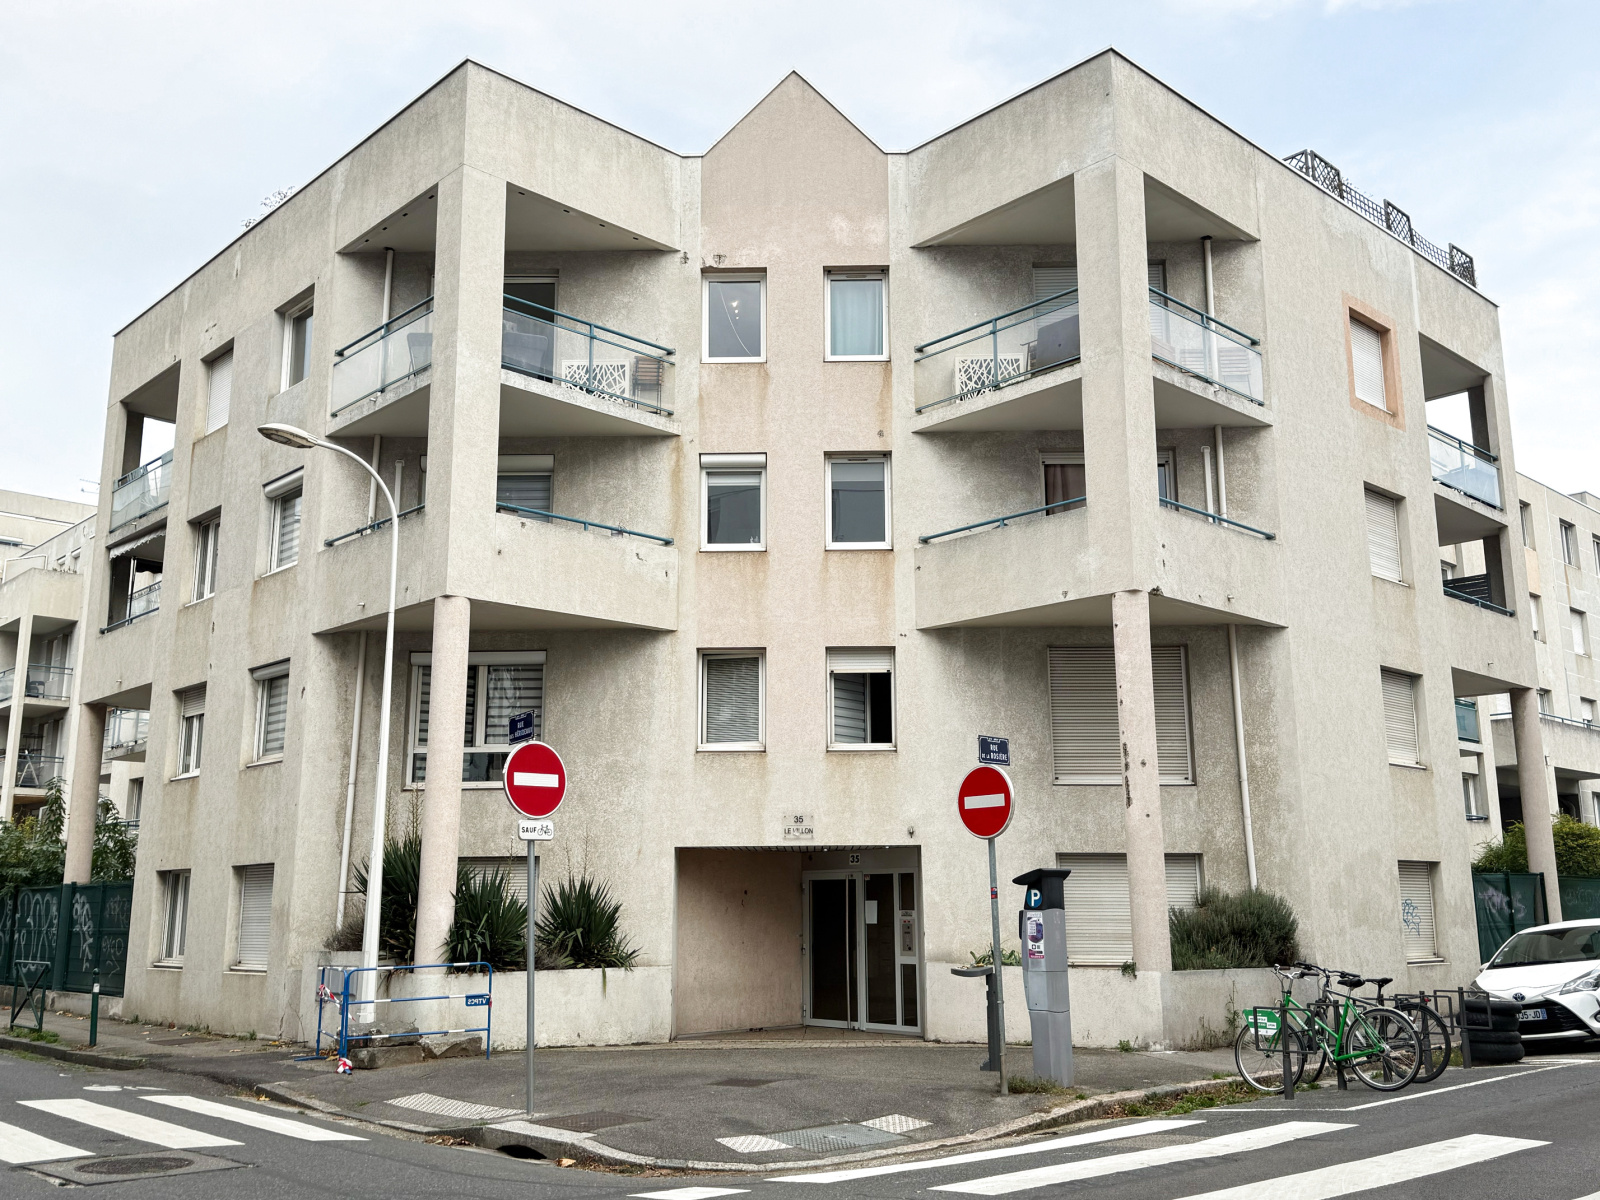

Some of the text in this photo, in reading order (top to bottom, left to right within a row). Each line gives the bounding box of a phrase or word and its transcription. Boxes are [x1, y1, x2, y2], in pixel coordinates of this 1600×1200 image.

[990, 744, 998, 752] RUE
[793, 815, 804, 824] 35
[521, 826, 537, 834] SAUF
[784, 827, 791, 835] LE
[850, 855, 860, 863] 35
[1030, 889, 1041, 907] P
